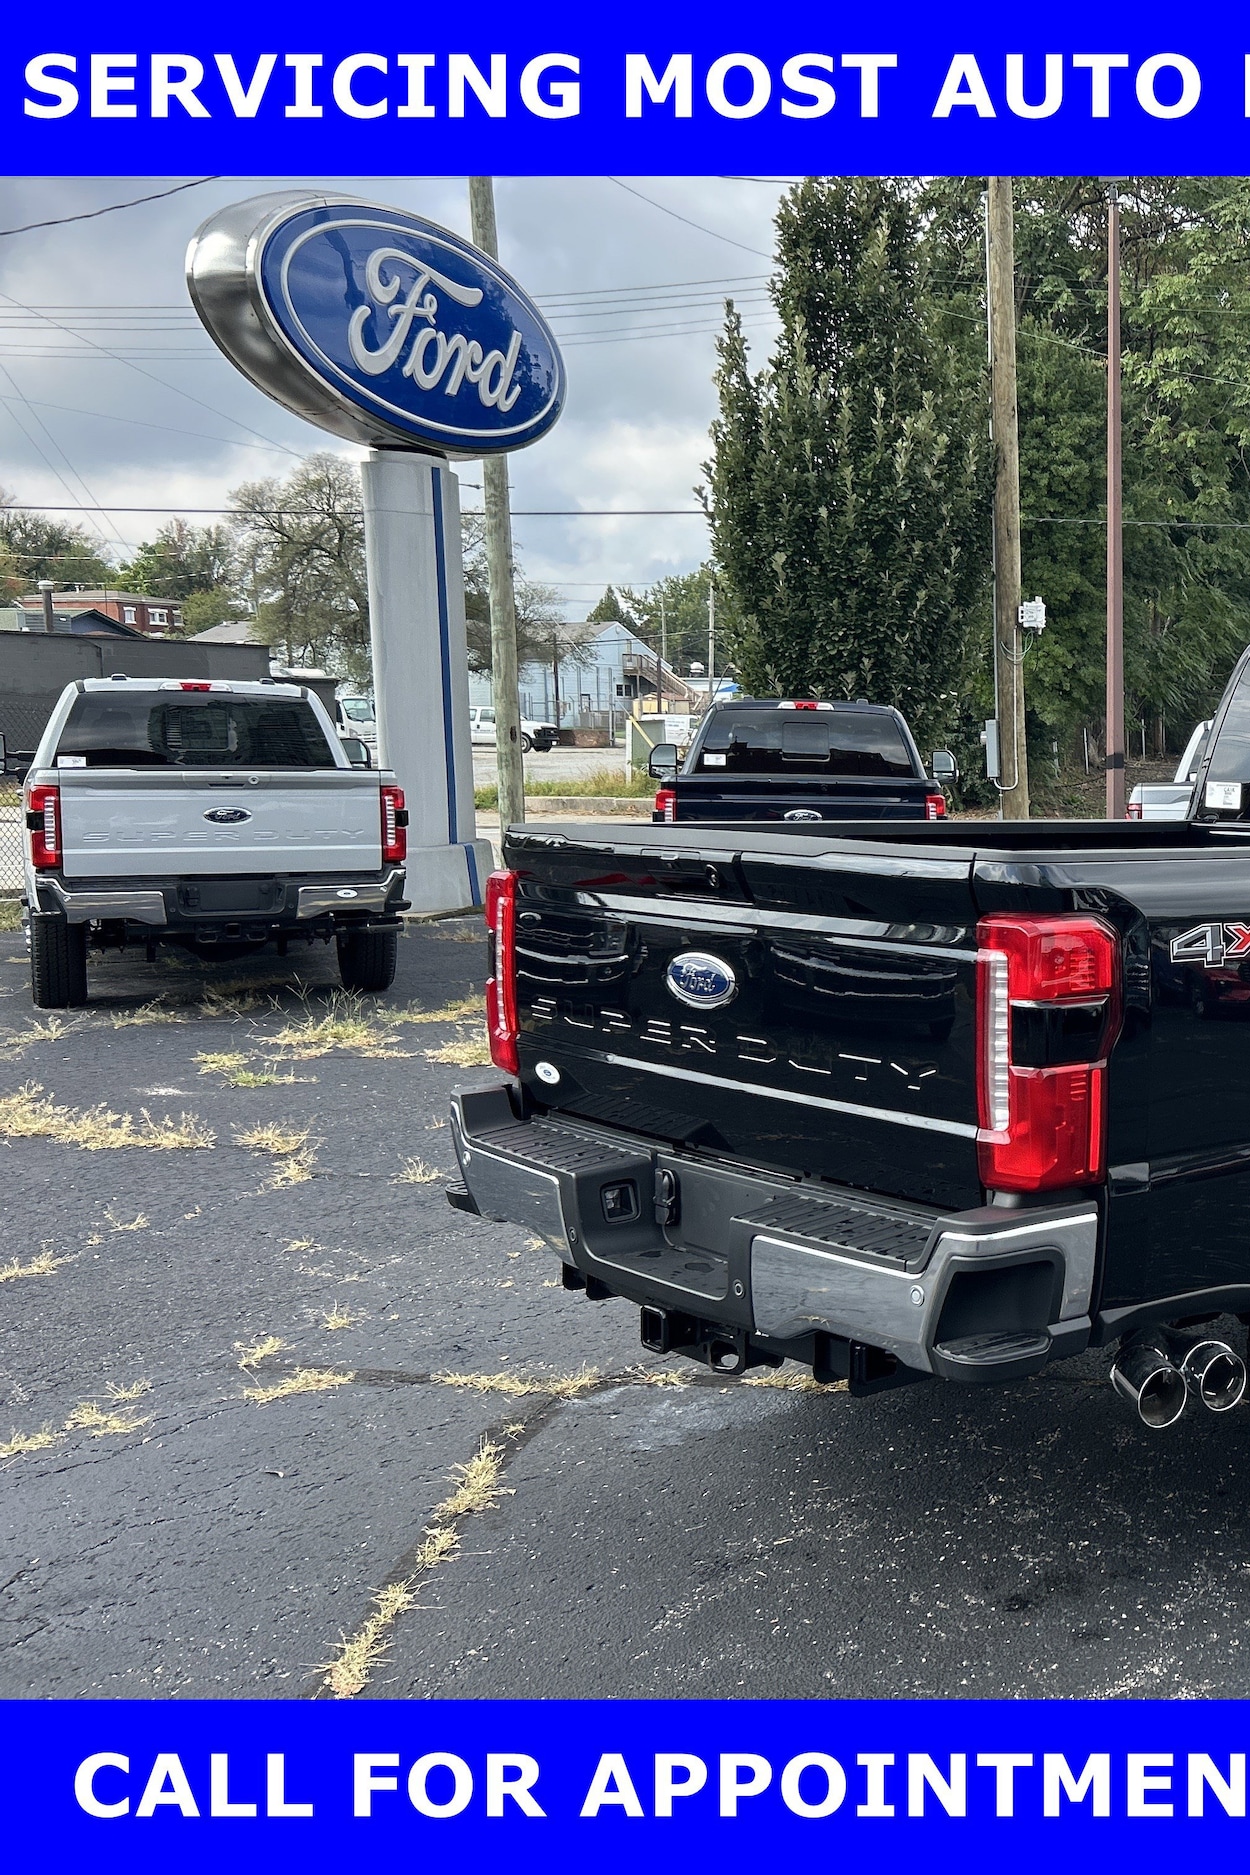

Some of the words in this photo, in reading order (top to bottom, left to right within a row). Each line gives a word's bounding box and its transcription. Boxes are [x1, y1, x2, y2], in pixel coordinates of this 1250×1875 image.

[349, 246, 523, 413] Ford
[214, 809, 241, 821] Ford
[82, 828, 241, 843] SUPER
[252, 828, 366, 841] DUTY
[679, 962, 717, 993] Ford
[530, 994, 718, 1054] SUPER
[736, 1033, 939, 1091] DUTY
